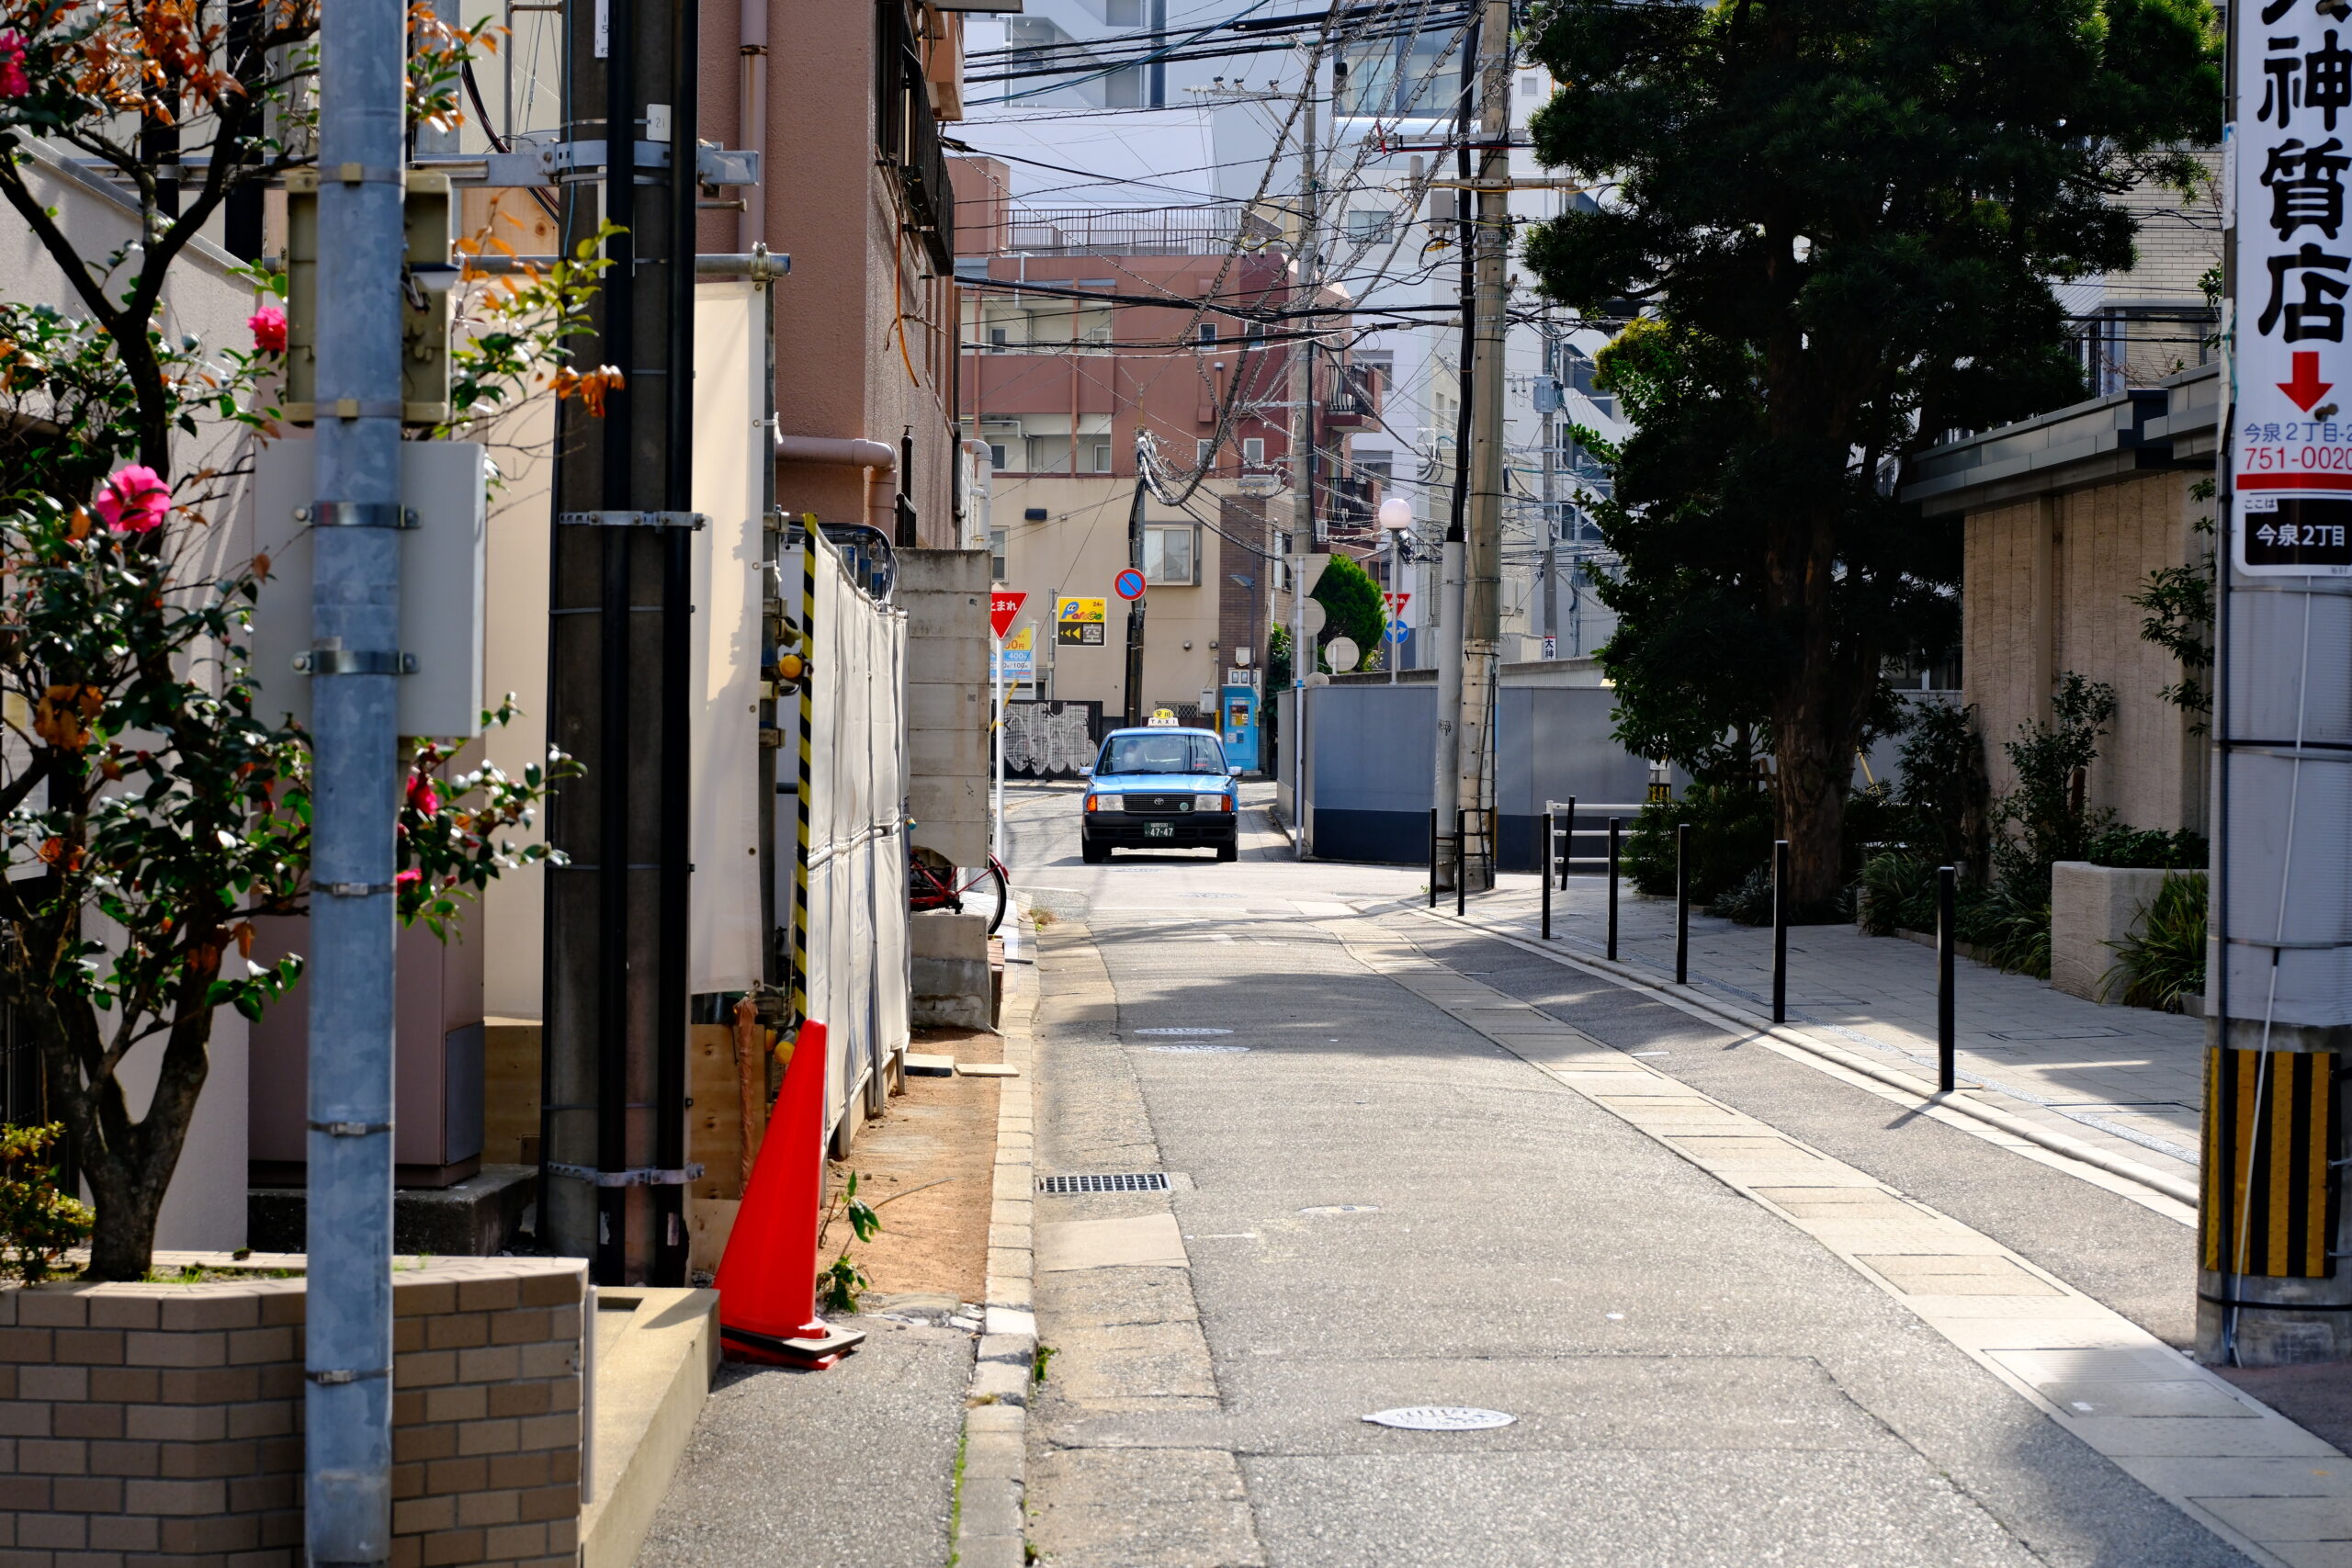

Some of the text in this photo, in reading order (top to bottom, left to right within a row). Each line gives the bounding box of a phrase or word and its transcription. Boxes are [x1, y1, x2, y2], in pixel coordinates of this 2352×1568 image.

[2244, 499, 2276, 510] ここは
[2256, 523, 2346, 547] 今泉2丁目
[1544, 638, 1554, 659] 大神
[1150, 828, 1174, 837] 47-47
